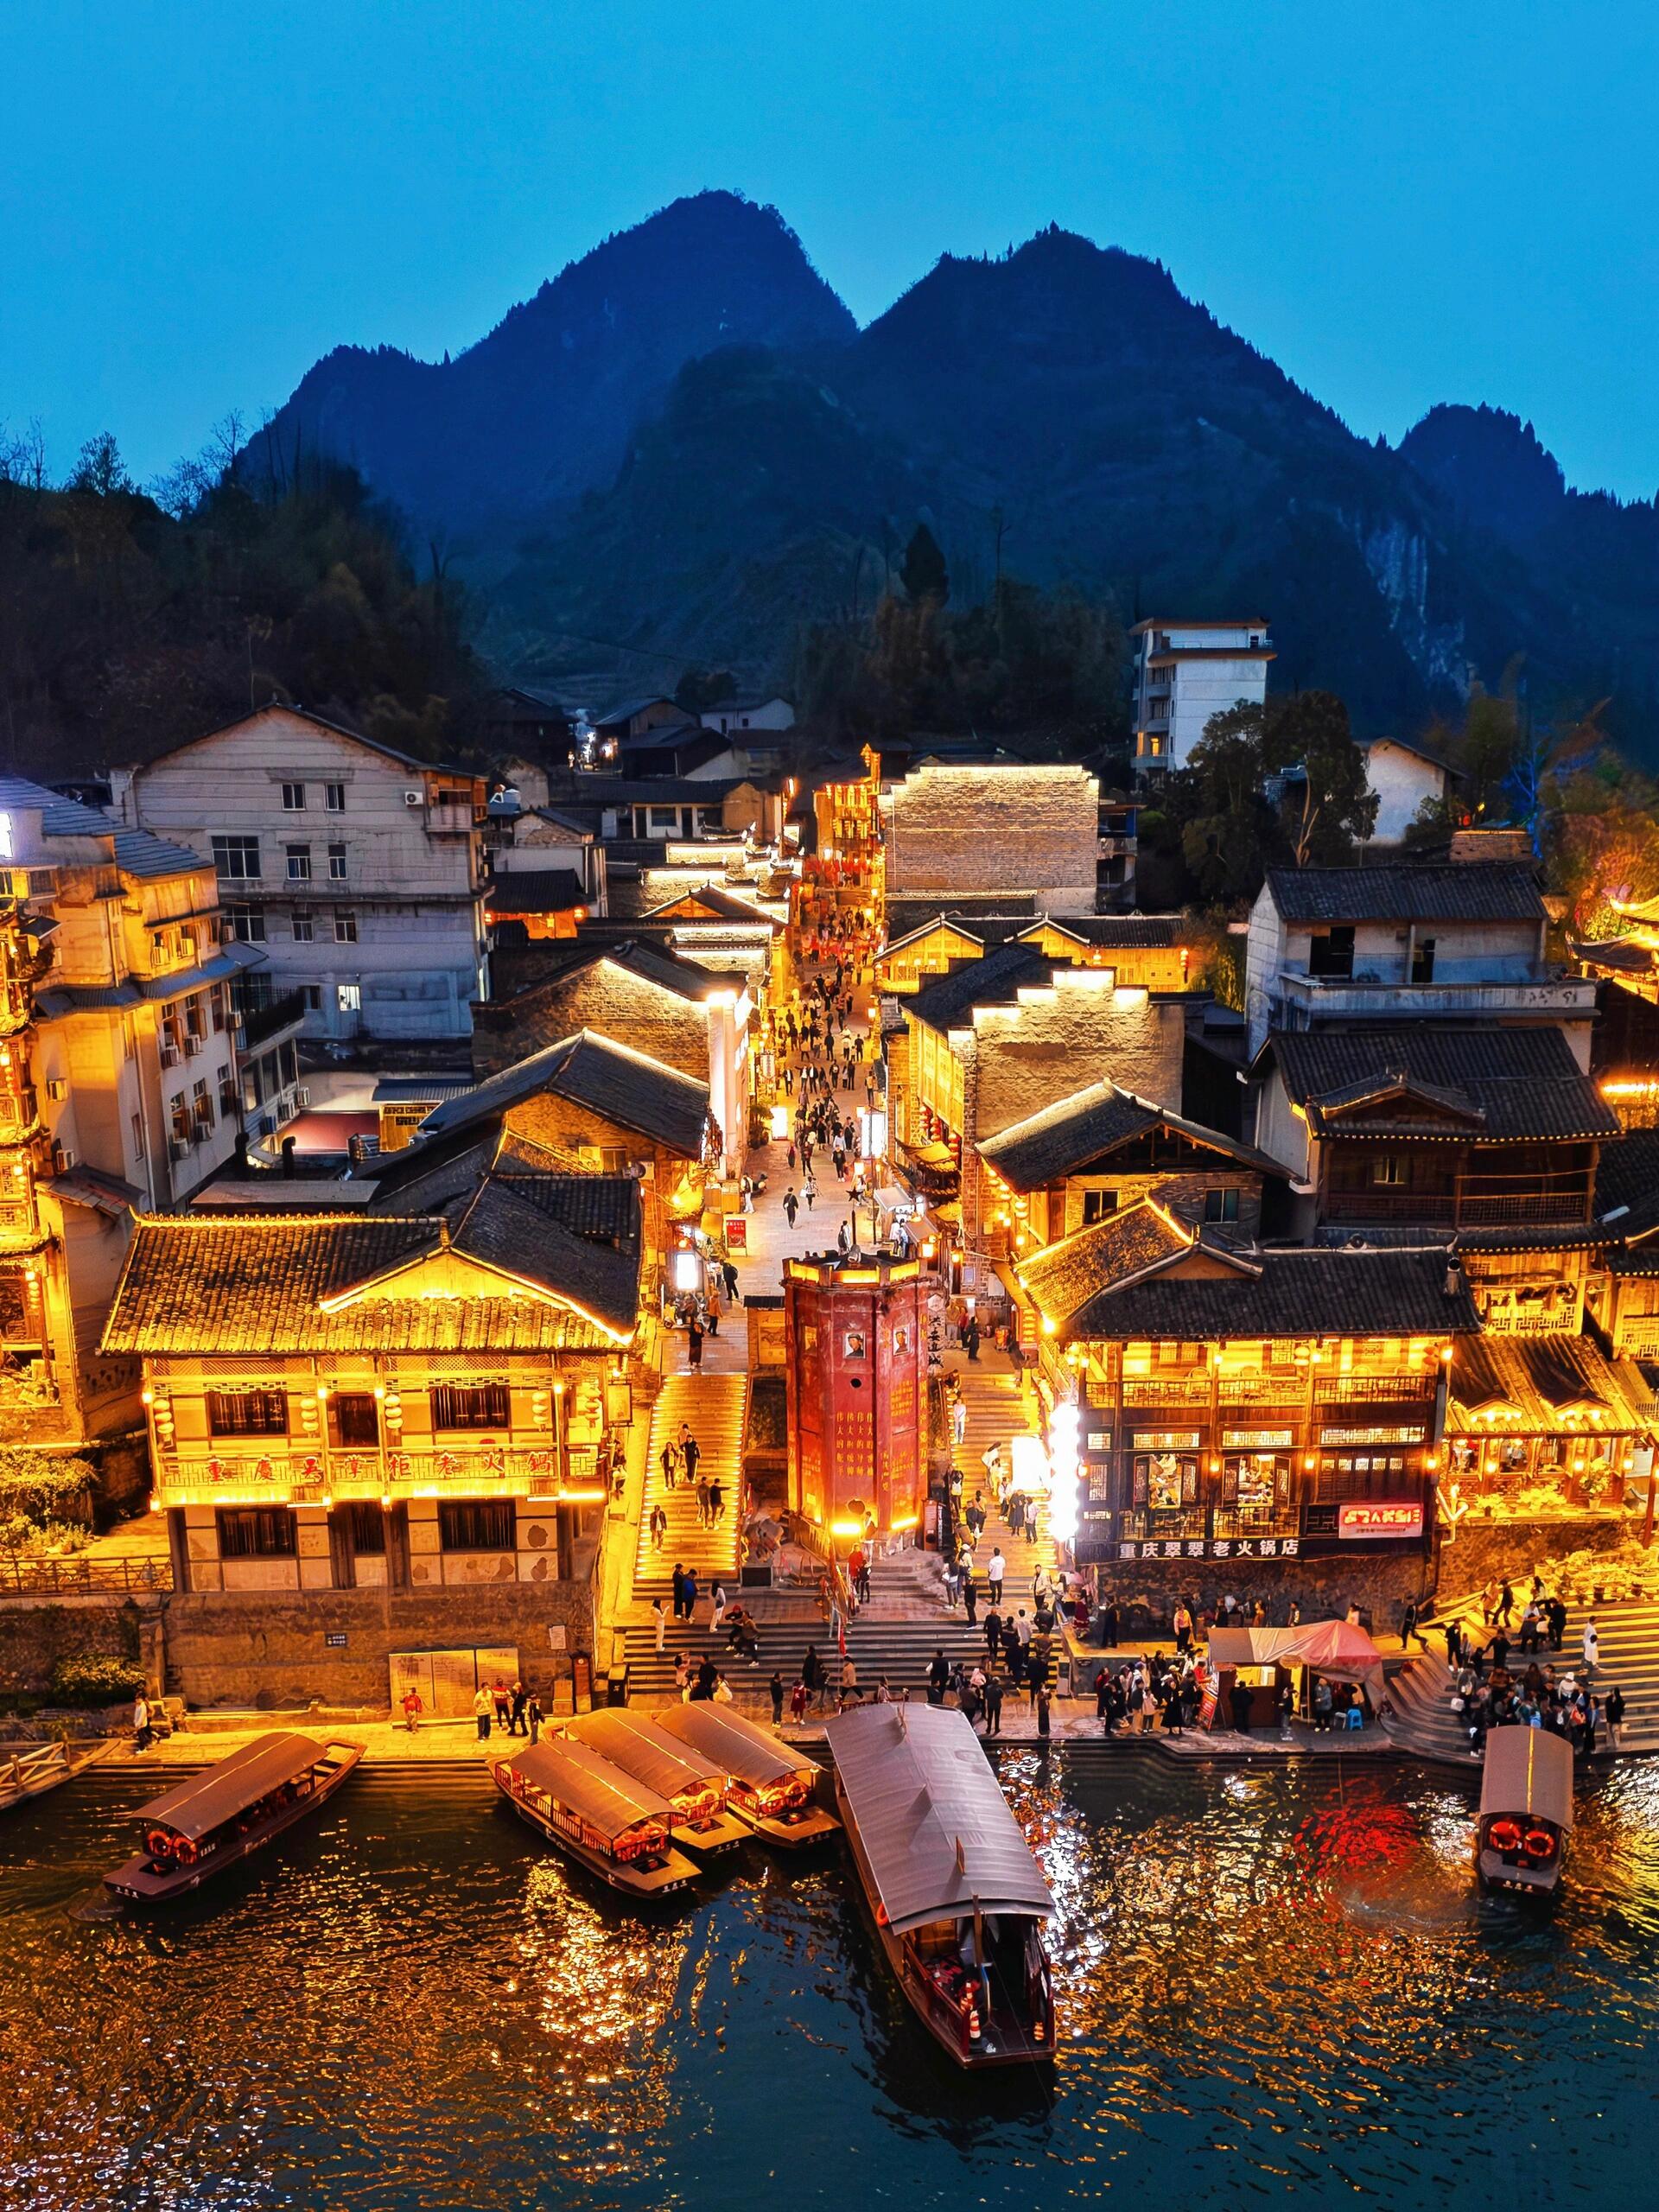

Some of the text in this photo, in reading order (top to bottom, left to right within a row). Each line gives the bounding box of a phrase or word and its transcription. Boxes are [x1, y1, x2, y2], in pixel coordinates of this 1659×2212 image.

[1119, 1539, 1300, 1559] 重庆翠翠老火锅店
